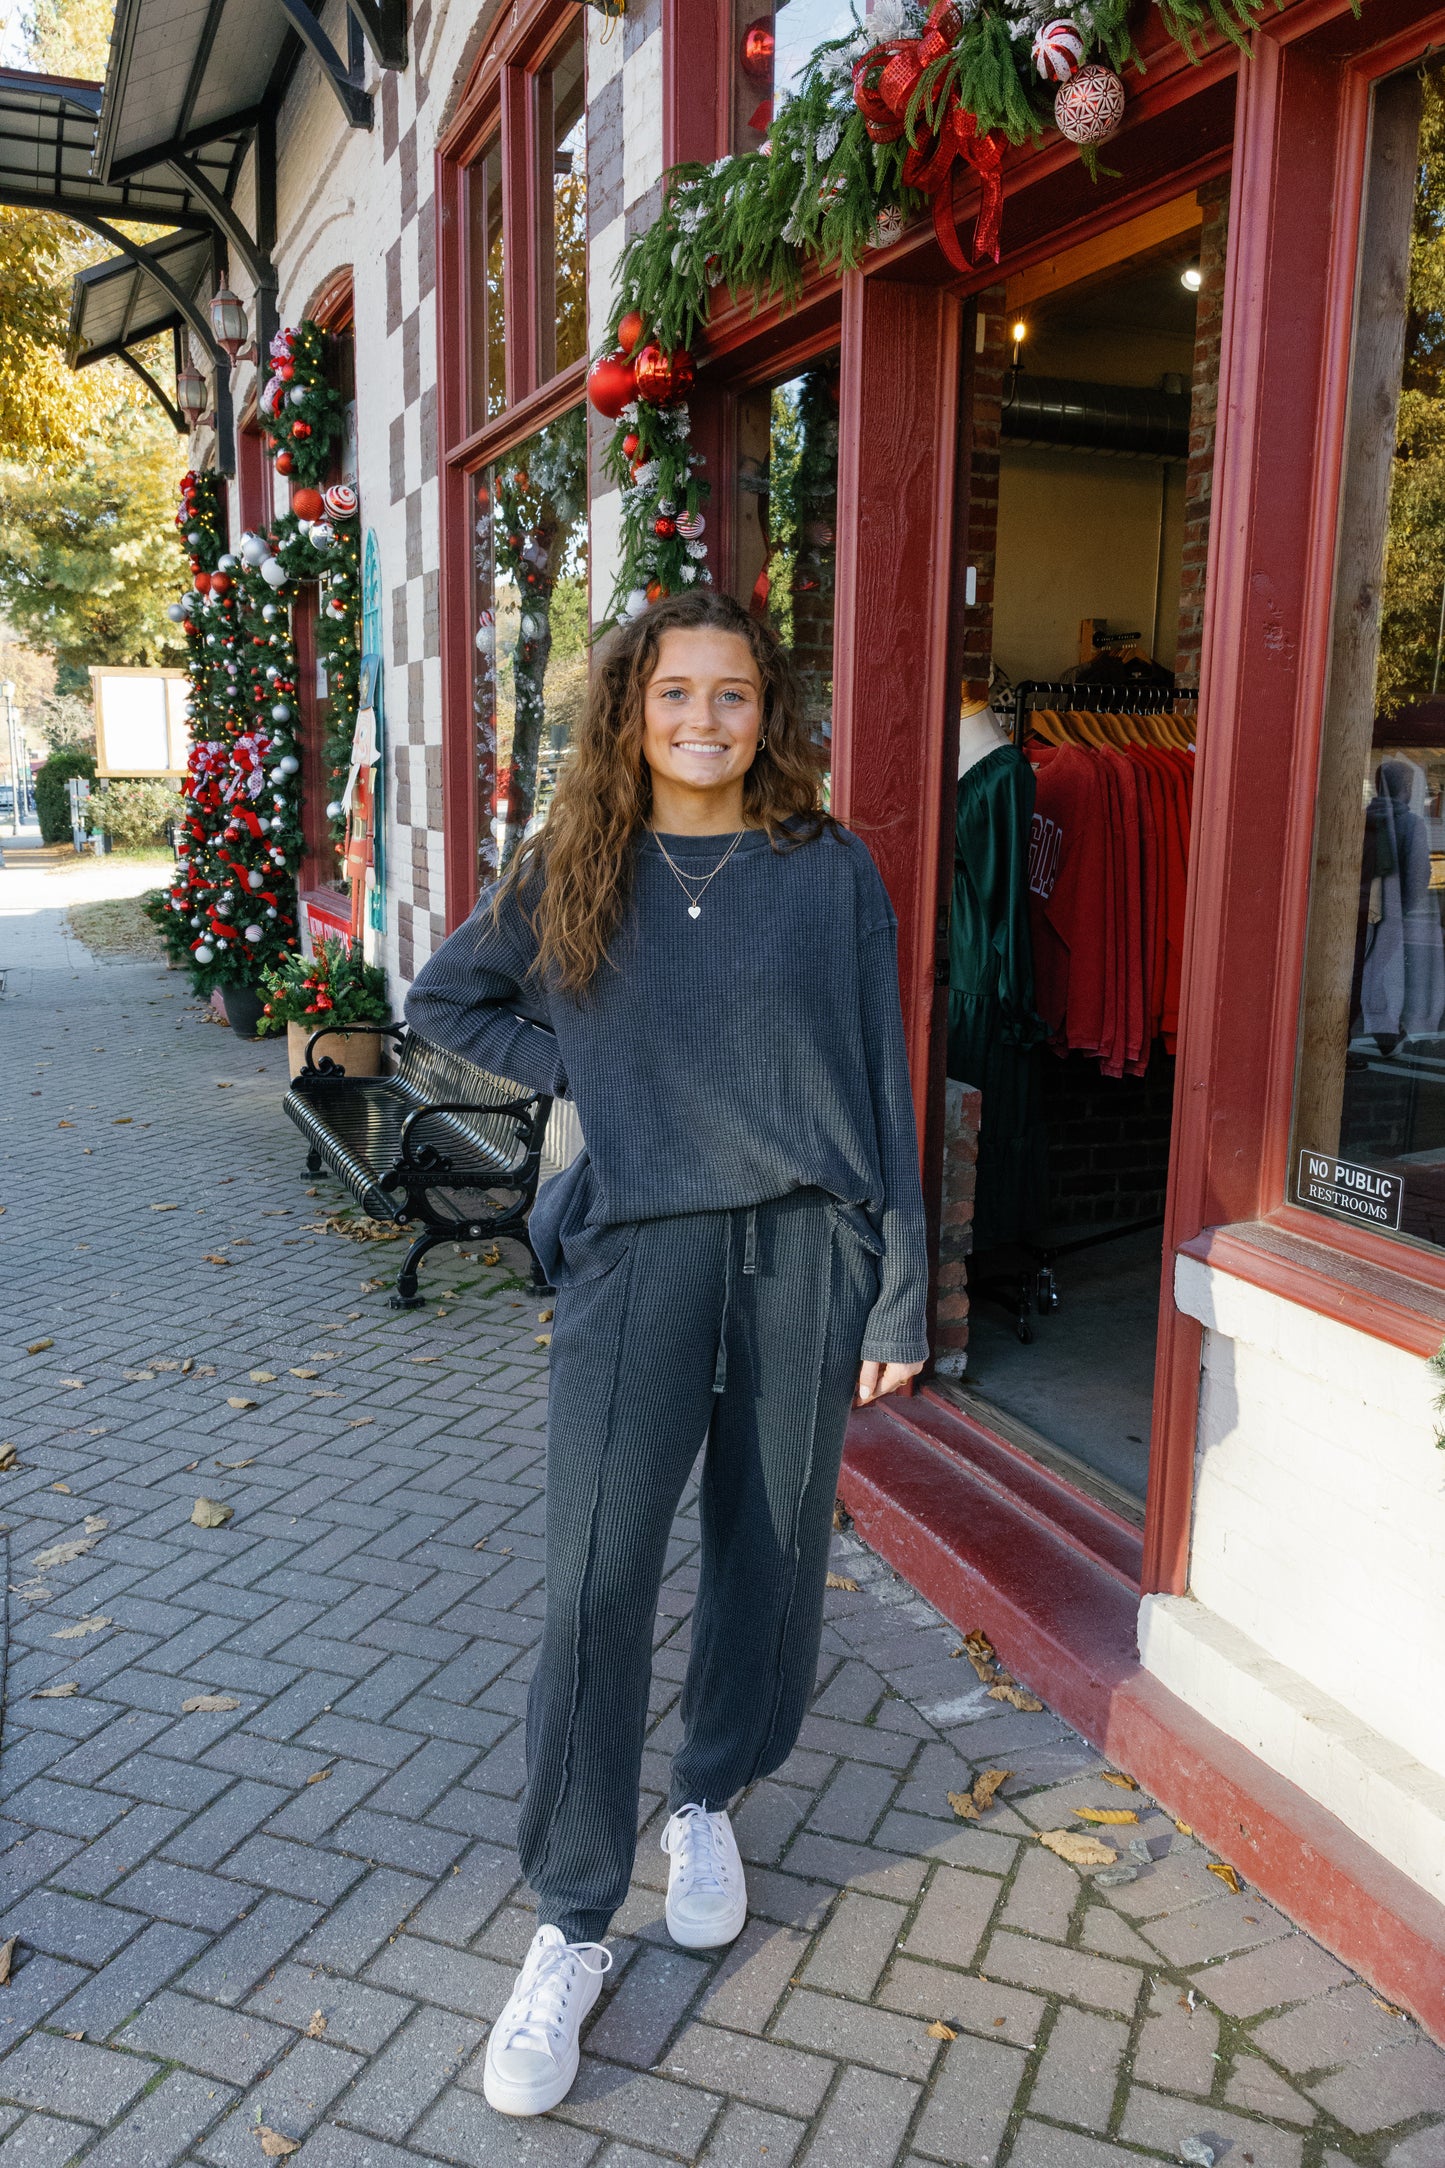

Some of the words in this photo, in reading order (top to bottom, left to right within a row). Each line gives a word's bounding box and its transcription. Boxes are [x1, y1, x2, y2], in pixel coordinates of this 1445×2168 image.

[1309, 1158, 1328, 1178] NO
[1334, 1165, 1392, 1198] PUBLIC
[1309, 1184, 1388, 1220] RESTROOMS
